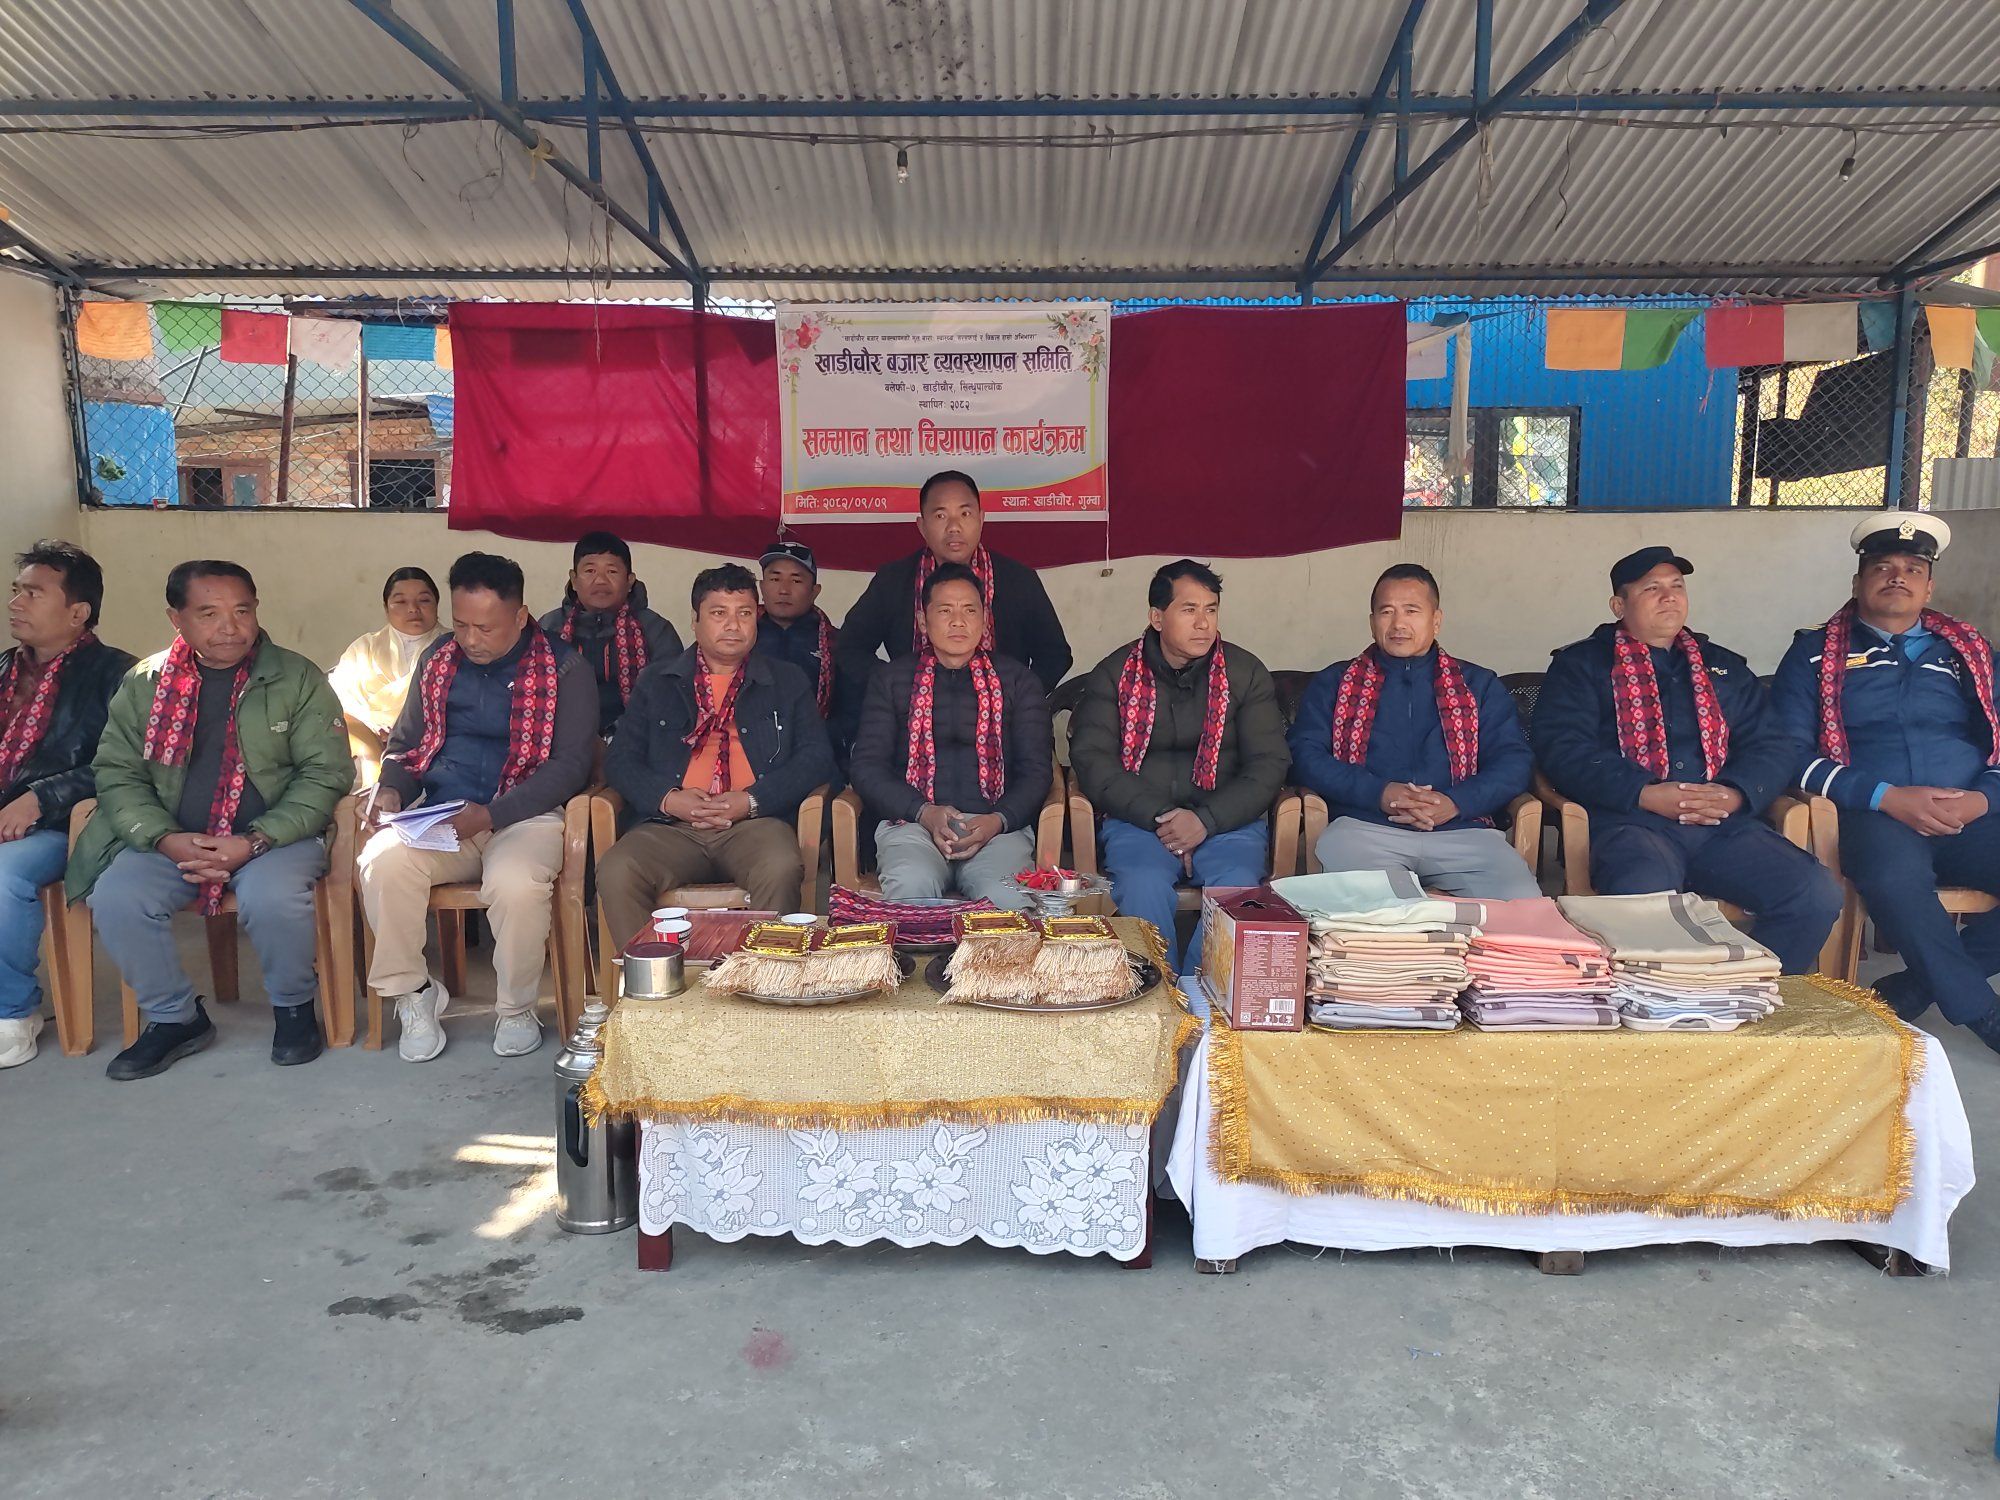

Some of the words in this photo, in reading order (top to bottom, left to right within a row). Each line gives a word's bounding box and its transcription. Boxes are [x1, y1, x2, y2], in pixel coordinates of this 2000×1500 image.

[814, 347, 882, 374] खाडीचौर
[886, 353, 929, 374] बजार
[933, 352, 1018, 374] व्यवस्थापन
[1022, 345, 1073, 373] समिति
[802, 428, 869, 458] सम्मान
[875, 428, 913, 457] तथा
[918, 418, 997, 456] चियापान
[1002, 419, 1086, 456] कार्यक्रम
[1033, 492, 1075, 507] खाडीचौर,
[1078, 495, 1101, 510] गुम्बा
